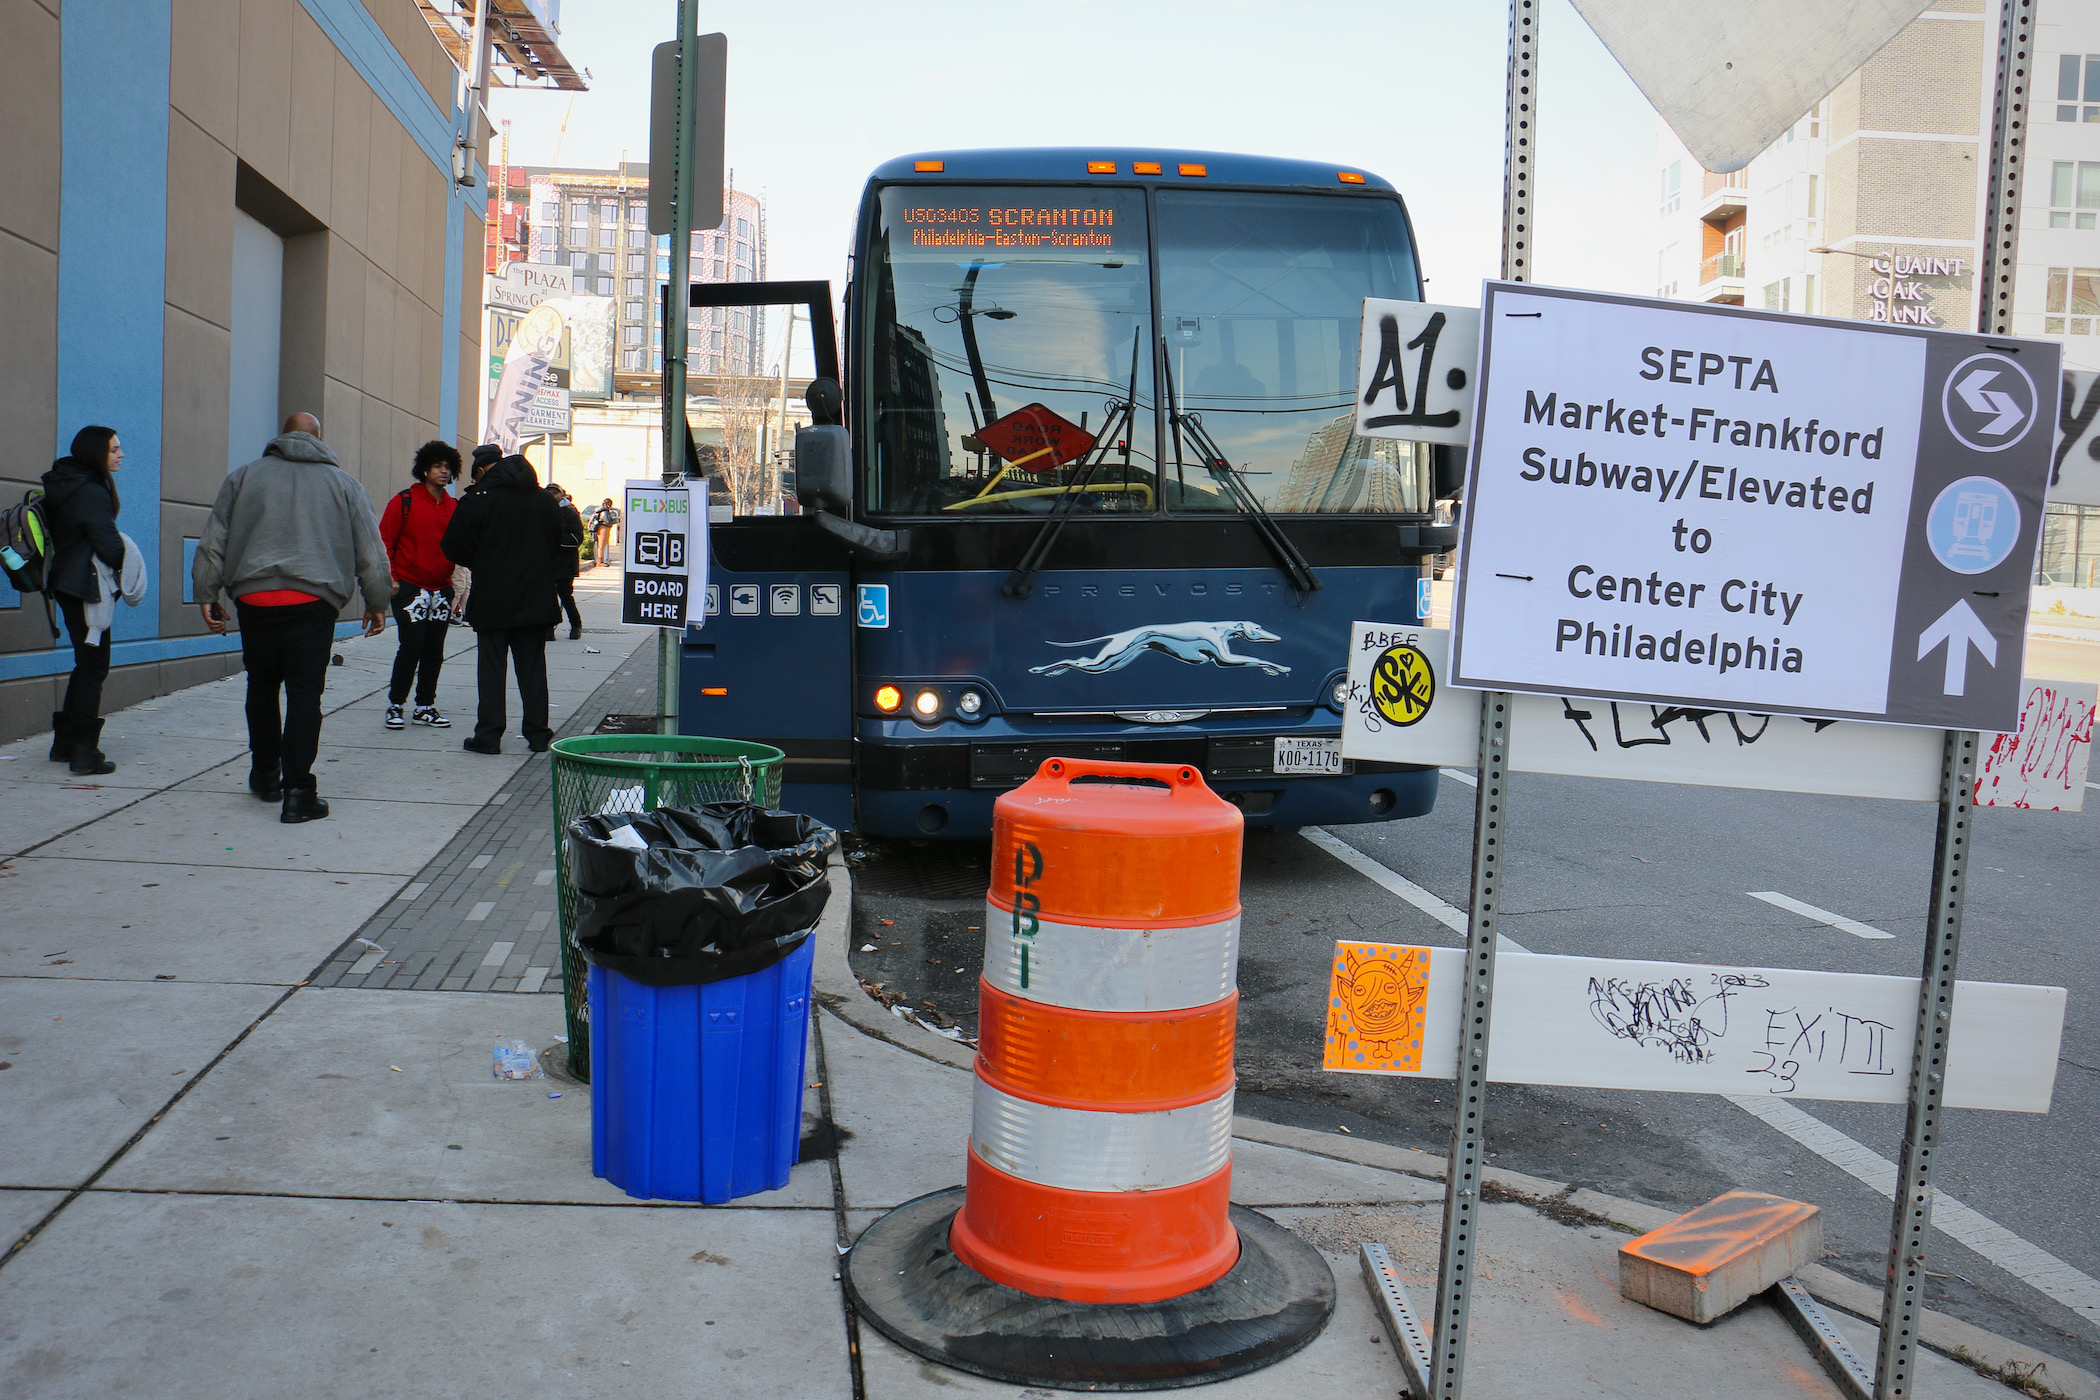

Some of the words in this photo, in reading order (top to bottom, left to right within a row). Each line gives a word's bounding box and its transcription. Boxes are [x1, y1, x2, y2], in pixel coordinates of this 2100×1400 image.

[988, 209, 1113, 226] SCRANTON
[1873, 251, 1965, 278] QUAINT
[524, 269, 567, 291] PLAZA
[1873, 277, 1924, 300] OAK
[494, 285, 528, 306] SPRING
[1873, 300, 1936, 325] BANK
[1638, 346, 1780, 393] SEPTA
[536, 397, 560, 407] ACCESS
[526, 416, 555, 426] LEANERS
[530, 408, 567, 420] GARMENT
[1523, 389, 1884, 460] Market-Frankford
[1520, 446, 1875, 515] Subway/Elevated
[1671, 517, 1712, 554] to
[634, 579, 684, 597] BOARD
[1044, 582, 1278, 598] PREVOST
[1567, 564, 1706, 608] Center
[1720, 578, 1803, 626] City
[640, 602, 679, 620] HERE
[1554, 618, 1804, 674] Philadelphia
[1296, 740, 1323, 748] TEXAS
